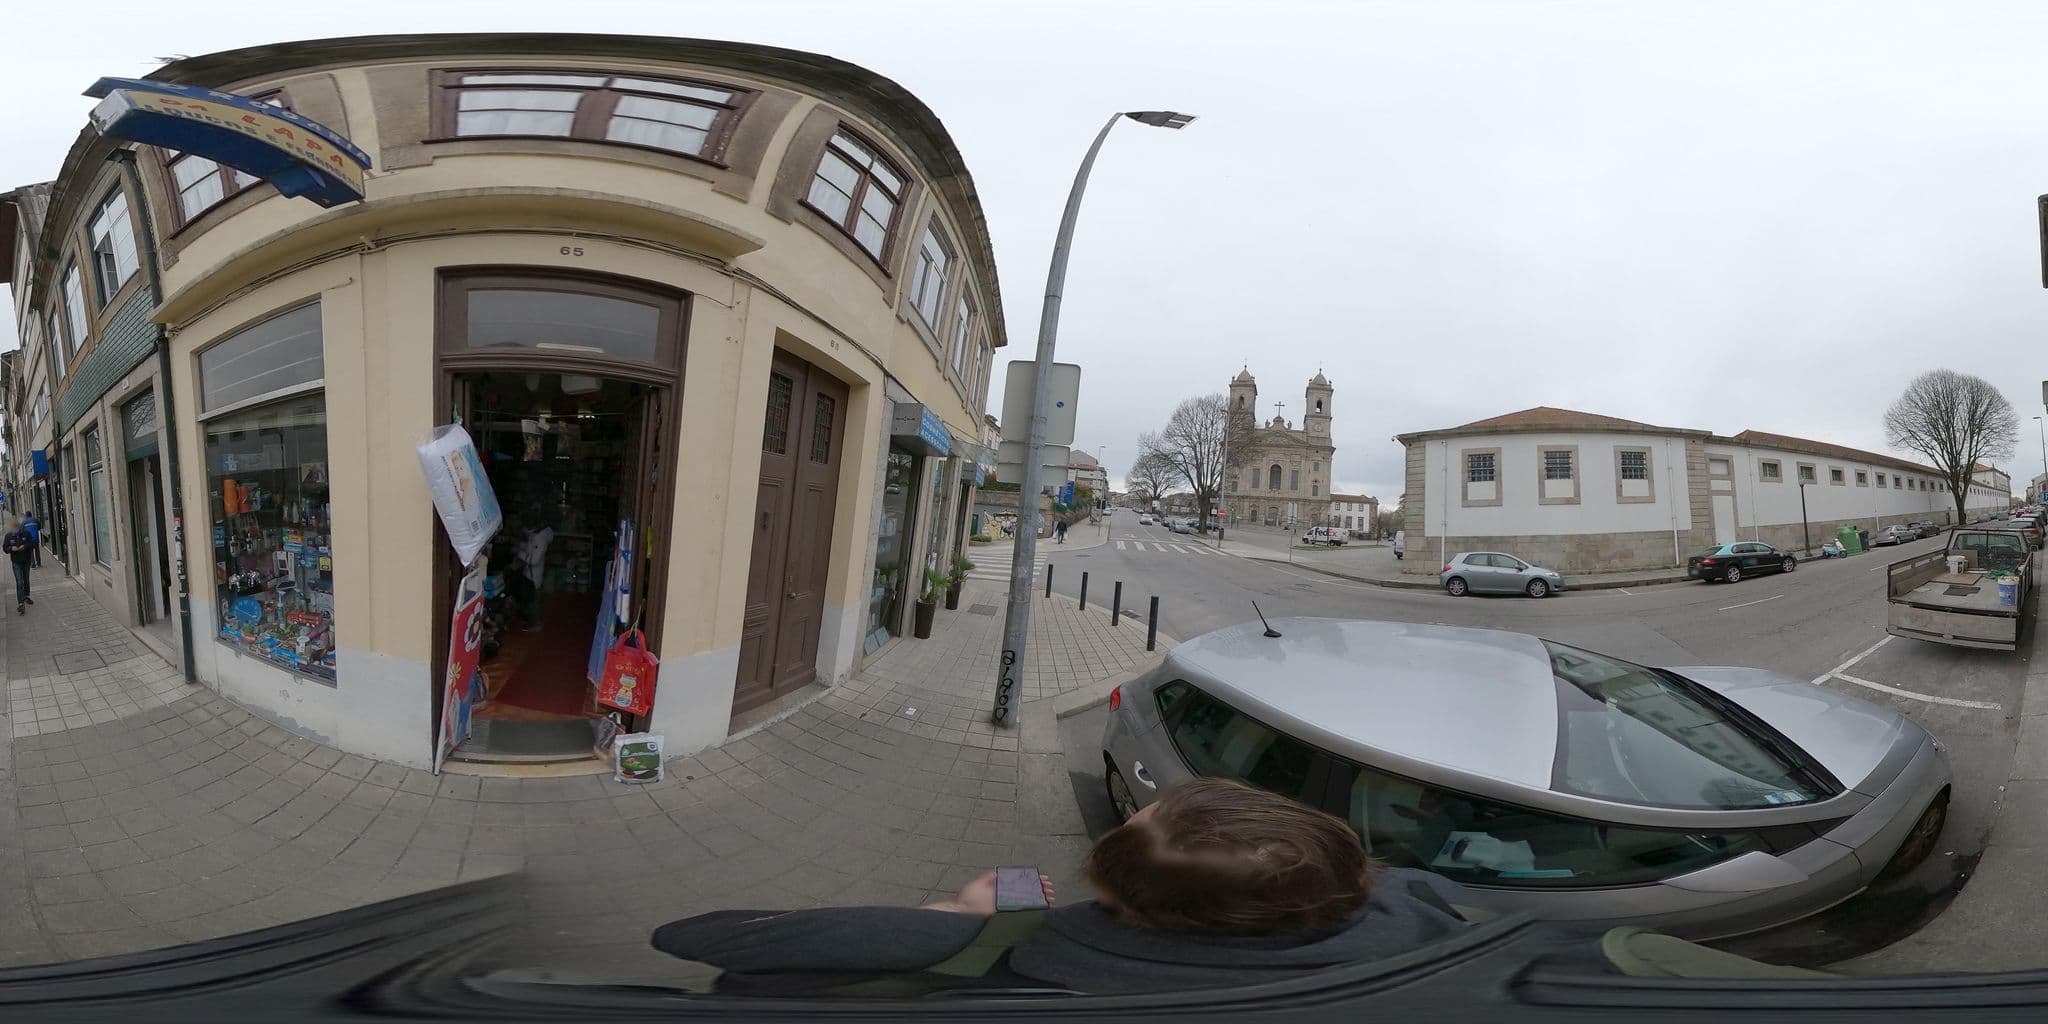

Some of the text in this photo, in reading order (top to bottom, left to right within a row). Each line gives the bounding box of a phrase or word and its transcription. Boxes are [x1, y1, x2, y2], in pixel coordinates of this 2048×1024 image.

[160, 98, 344, 167] DA LAPA
[560, 246, 584, 256] 65
[1314, 527, 1337, 537] FedEx
